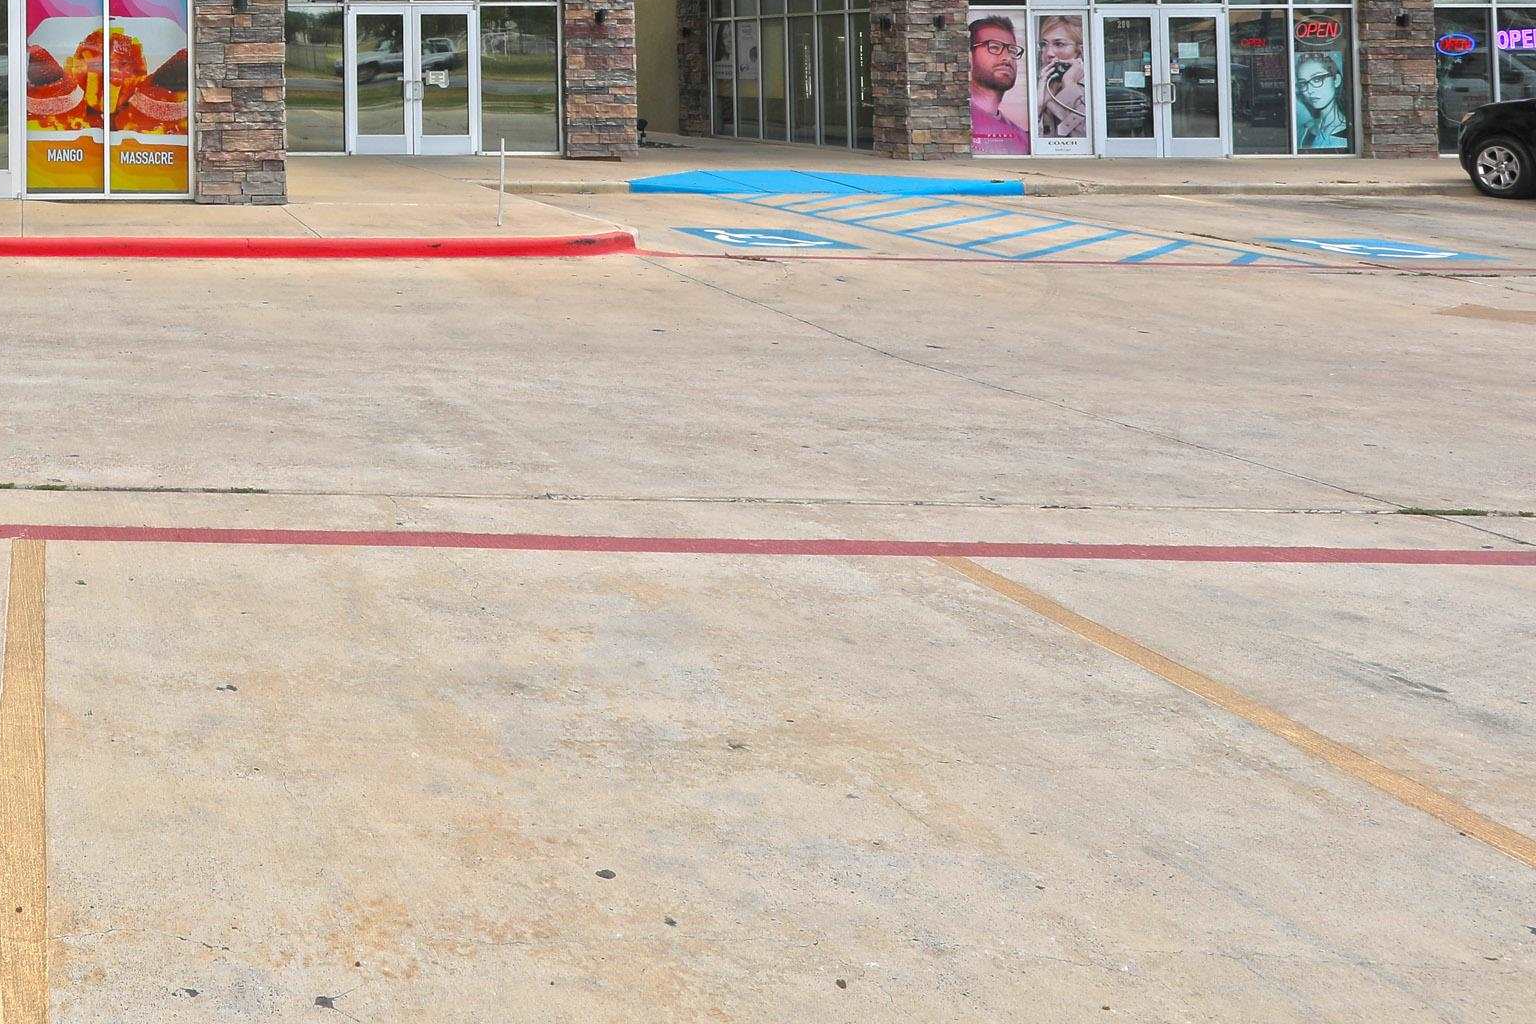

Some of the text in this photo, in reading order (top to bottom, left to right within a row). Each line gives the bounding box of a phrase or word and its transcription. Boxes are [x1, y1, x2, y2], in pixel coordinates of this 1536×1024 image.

[1296, 22, 1338, 38] OPEN
[1496, 29, 1536, 49] OPE
[47, 149, 83, 162] MANGO
[120, 151, 174, 165] MASSACRE
